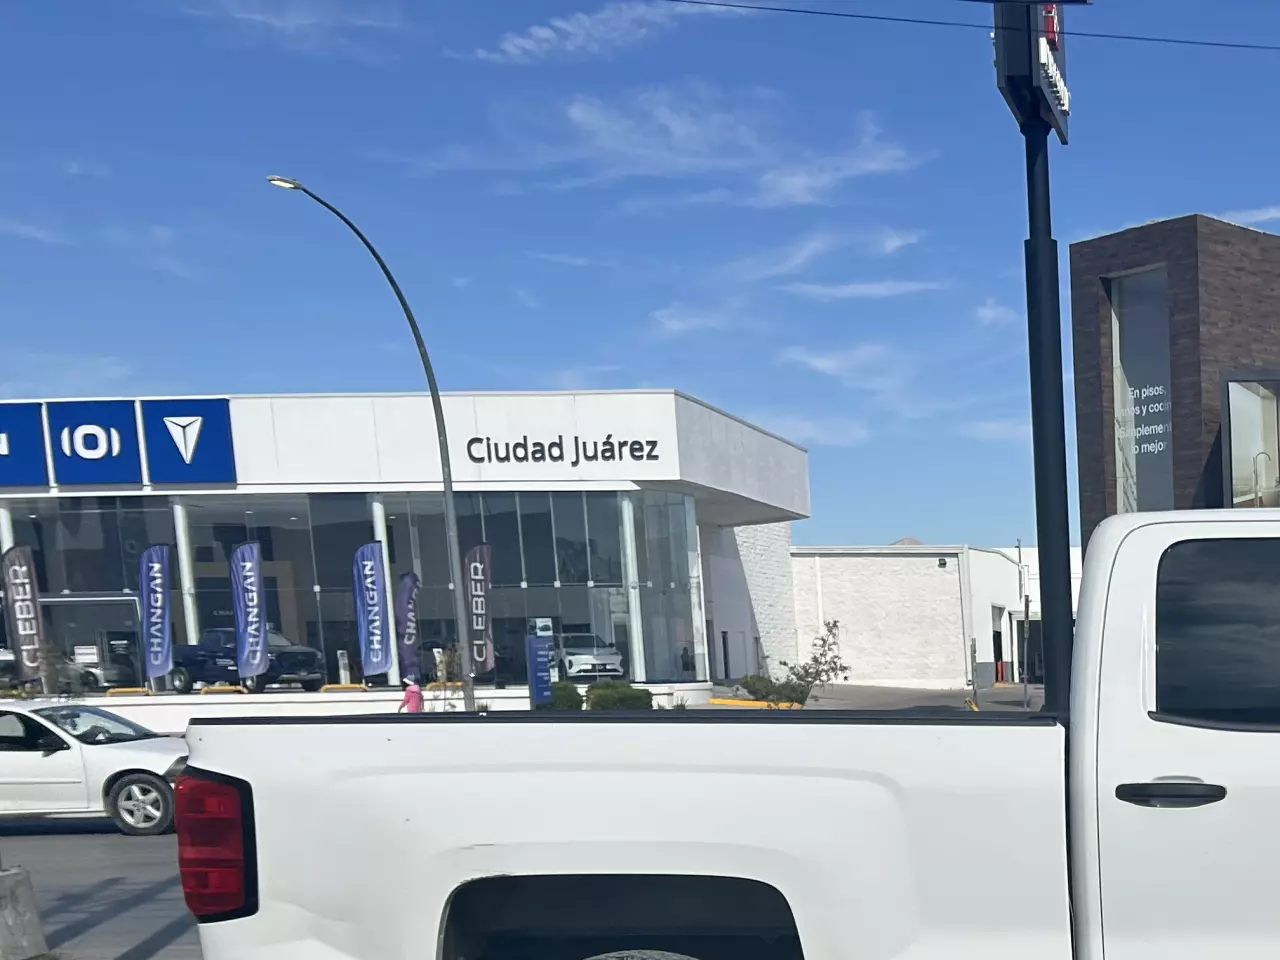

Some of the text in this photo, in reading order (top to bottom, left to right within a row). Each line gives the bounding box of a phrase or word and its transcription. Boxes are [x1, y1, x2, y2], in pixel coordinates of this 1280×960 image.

[466, 434, 660, 467] Ciudad Juárez
[9, 563, 42, 667] CLEBER
[148, 562, 164, 666] CHANGAN
[240, 561, 261, 664] CHANGAN
[362, 560, 382, 663] CHANGAN
[470, 561, 487, 662] CLEBER
